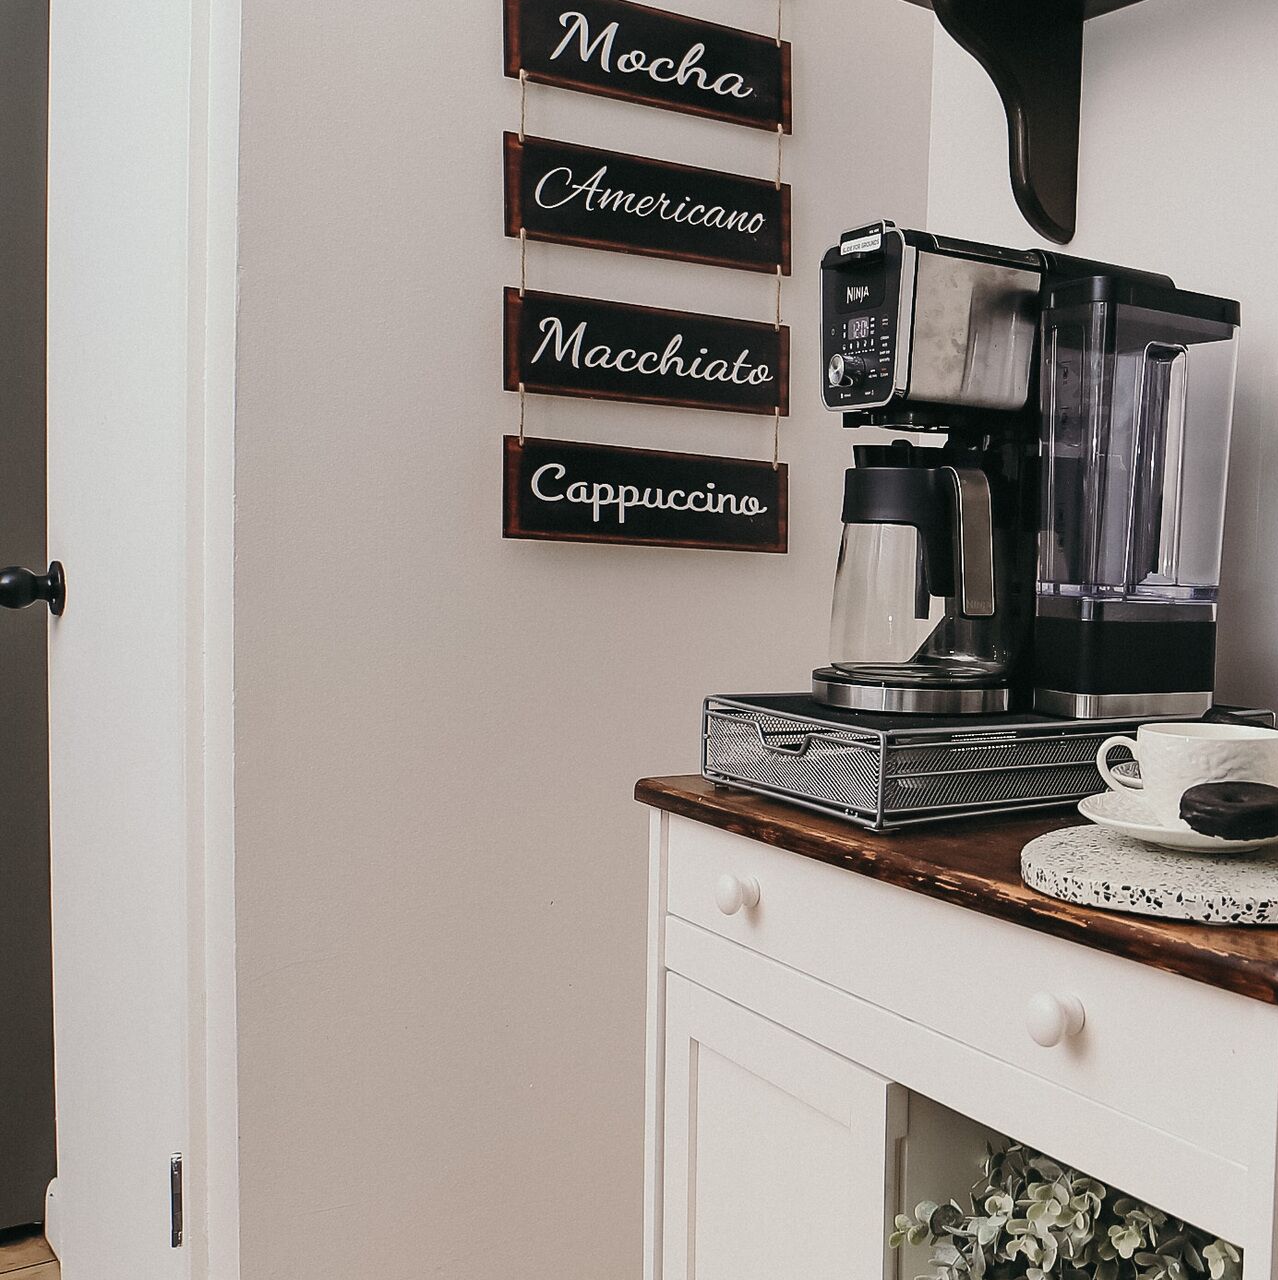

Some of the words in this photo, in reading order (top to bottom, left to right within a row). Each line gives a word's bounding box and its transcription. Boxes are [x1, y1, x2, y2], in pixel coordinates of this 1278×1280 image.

[549, 10, 753, 99] Mocha
[534, 165, 766, 234] Americano
[846, 285, 870, 304] NINJA
[531, 317, 773, 385] Macchiato
[530, 463, 768, 523] Cappuccino
